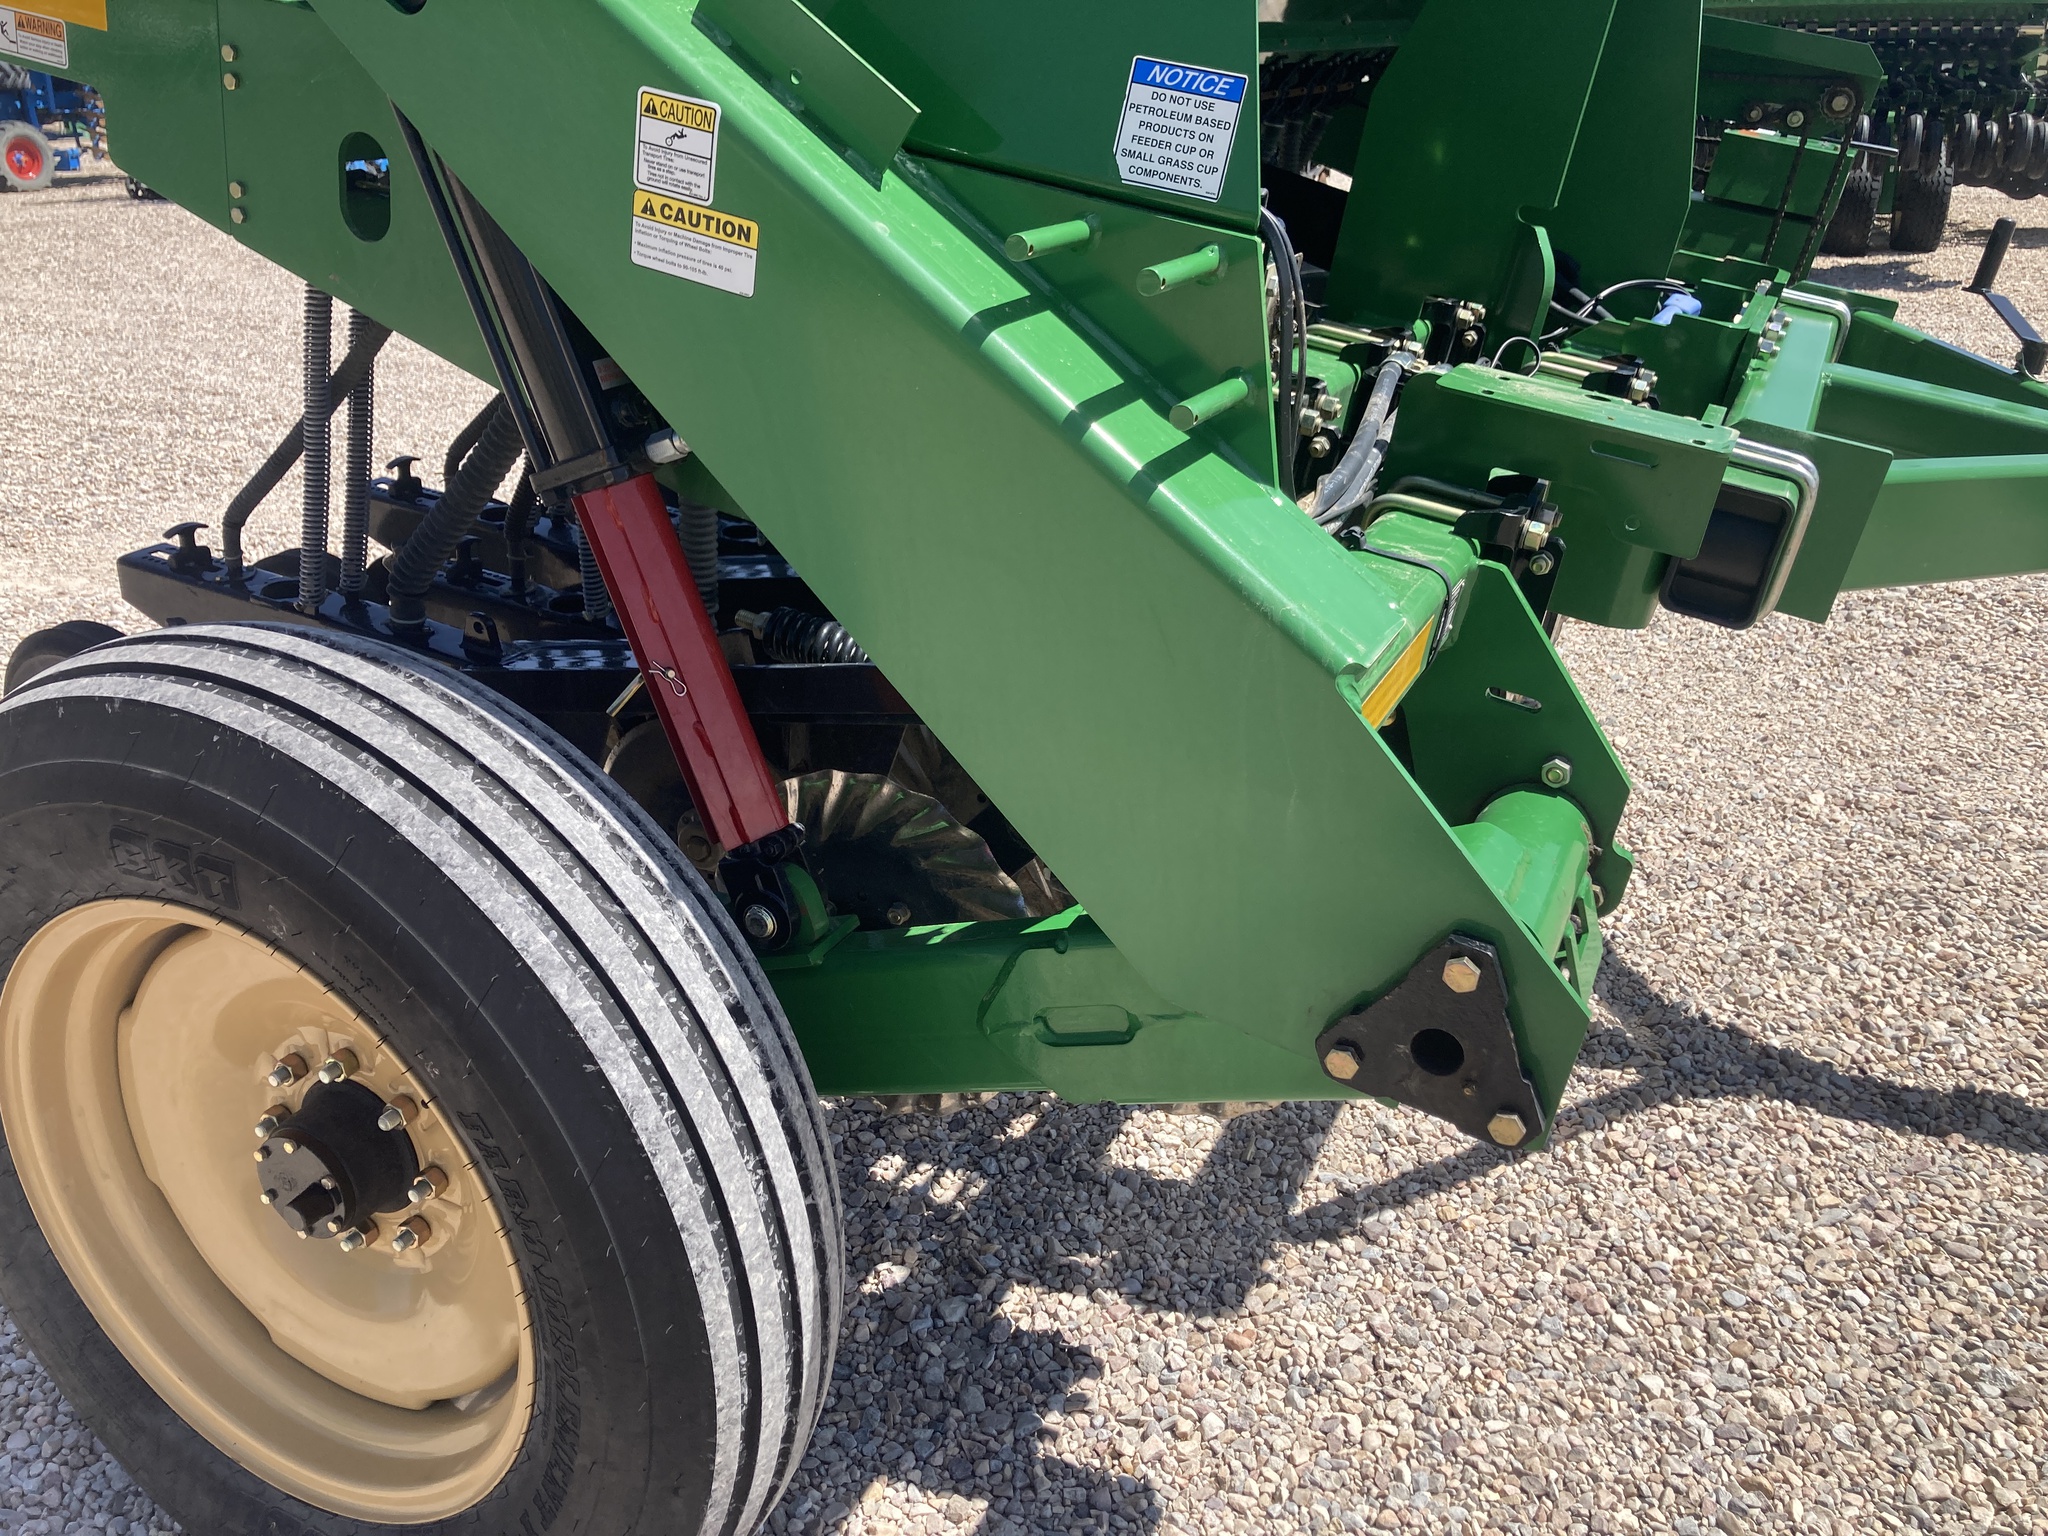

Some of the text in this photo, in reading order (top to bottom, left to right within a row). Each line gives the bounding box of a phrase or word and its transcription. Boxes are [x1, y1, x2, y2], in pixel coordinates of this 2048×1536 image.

[25, 16, 62, 38] WARNING
[1147, 65, 1234, 95] NOTICE
[1151, 92, 1216, 112] DO NOT USE
[660, 100, 712, 129] CAUTION
[1129, 103, 1231, 130] PETROLEUM BASED
[1138, 120, 1214, 144] PRODUCTS ON
[643, 150, 662, 160] Transport
[661, 149, 673, 157] Injury
[685, 154, 708, 165] Unsecured
[1131, 135, 1214, 160] FEEDER CUP OR
[687, 169, 705, 178] transport
[1120, 148, 1218, 176] SMALL GRASS CUP
[1128, 166, 1202, 188] COMPONENTS.
[660, 203, 751, 243] CAUTION
[635, 228, 652, 236] Inflation
[659, 235, 678, 246] Torquing
[684, 242, 698, 250] Wheel
[655, 226, 667, 235] Injury
[673, 232, 692, 241] Machine
[693, 238, 710, 247] Damage
[723, 246, 743, 256] Improper
[636, 251, 651, 259] Torque
[666, 259, 676, 267] bolts
[637, 241, 657, 250] Maximum
[677, 253, 696, 262] pressure
[109, 825, 241, 910] BKT
[456, 1111, 552, 1263] FARM
